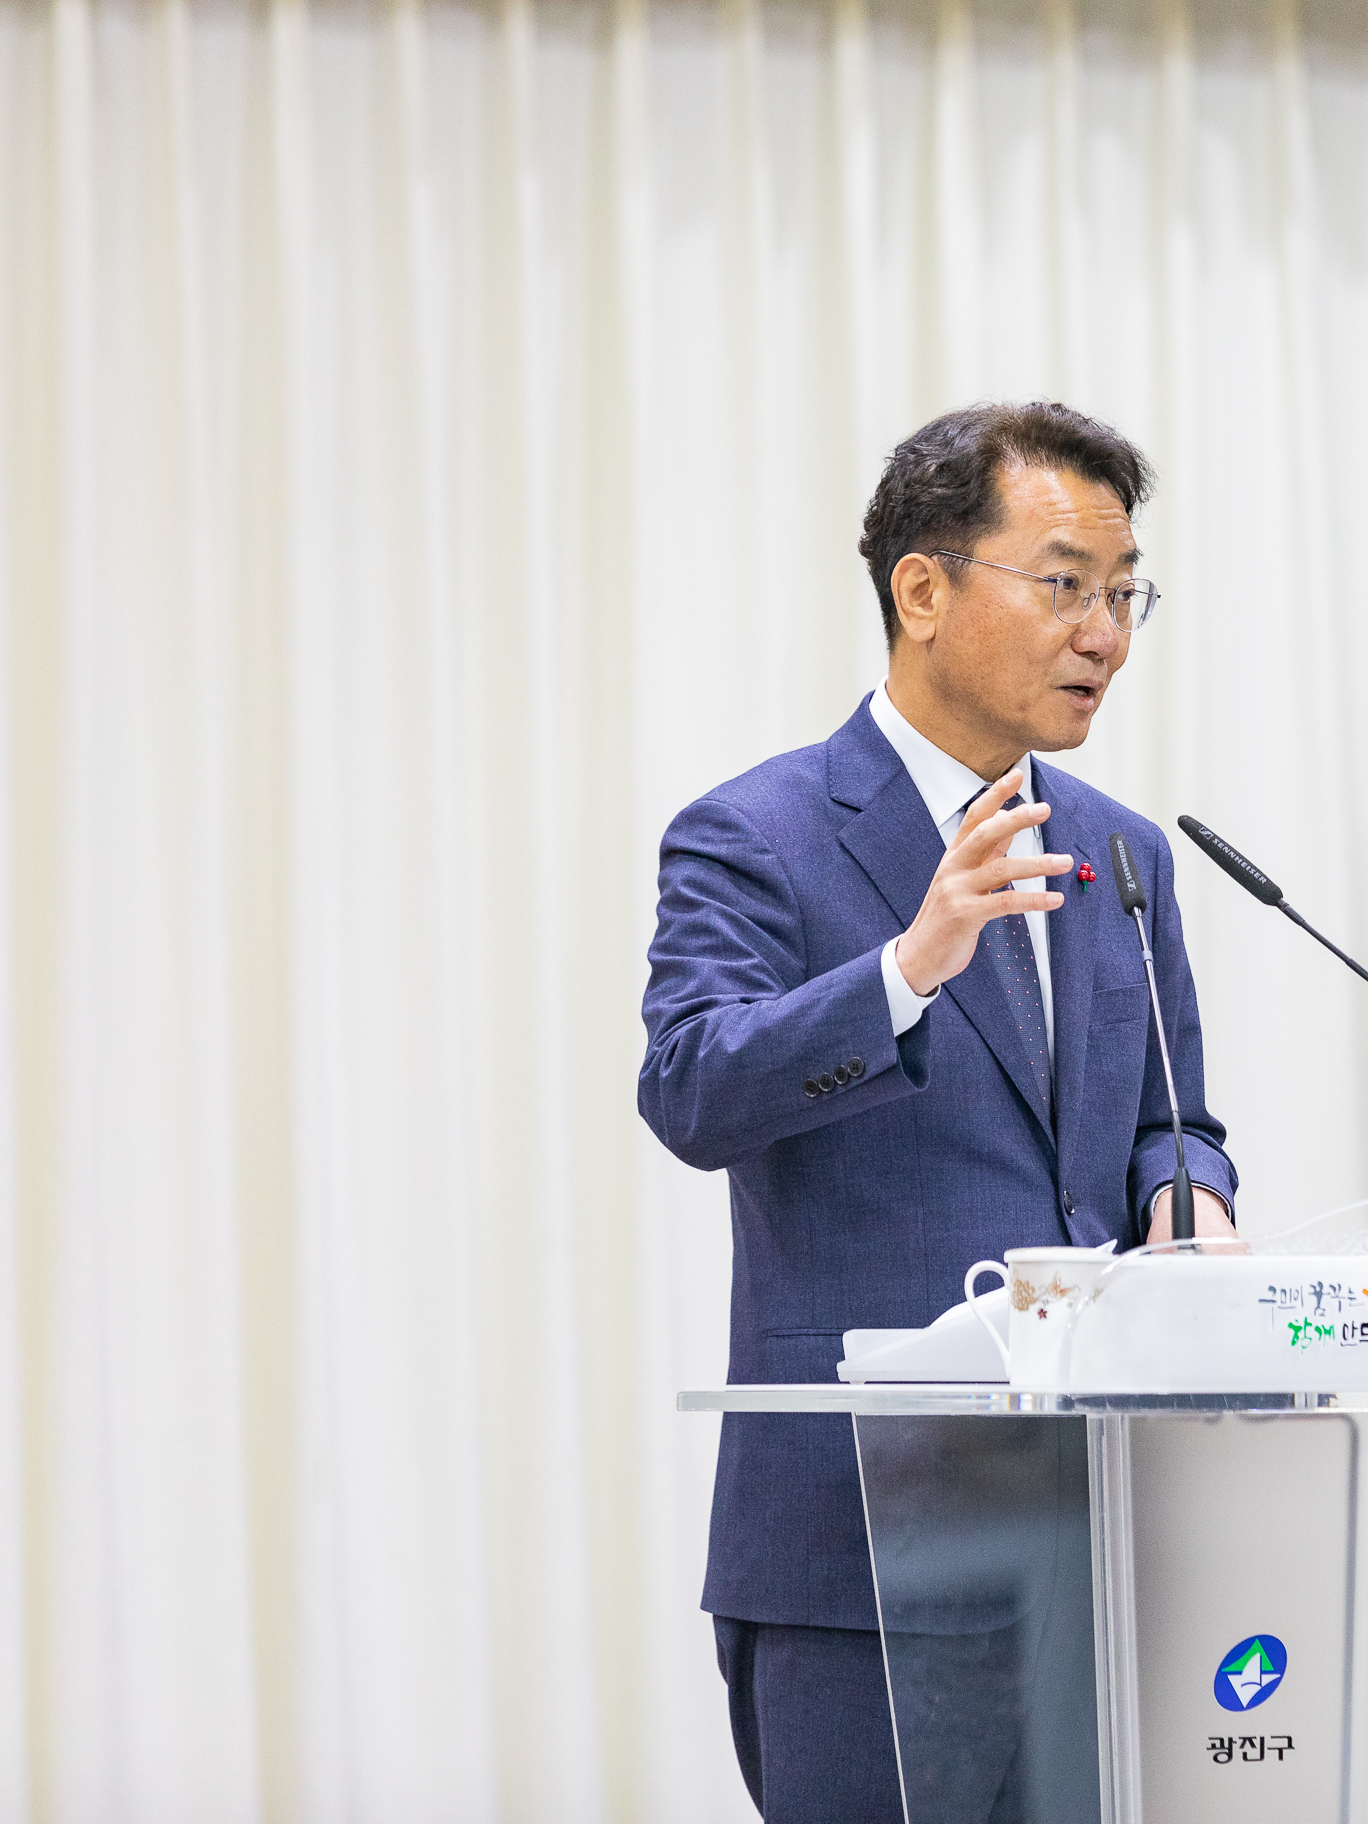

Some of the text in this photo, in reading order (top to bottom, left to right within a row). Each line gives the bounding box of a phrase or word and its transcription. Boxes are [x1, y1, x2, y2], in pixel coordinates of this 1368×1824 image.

[1212, 838, 1267, 884] SENNHEISER
[1258, 1285, 1304, 1333] 구민이
[1308, 1280, 1365, 1317] 꿈꾸는
[1287, 1316, 1335, 1355] 함께
[1206, 1735, 1296, 1765] 광진구
